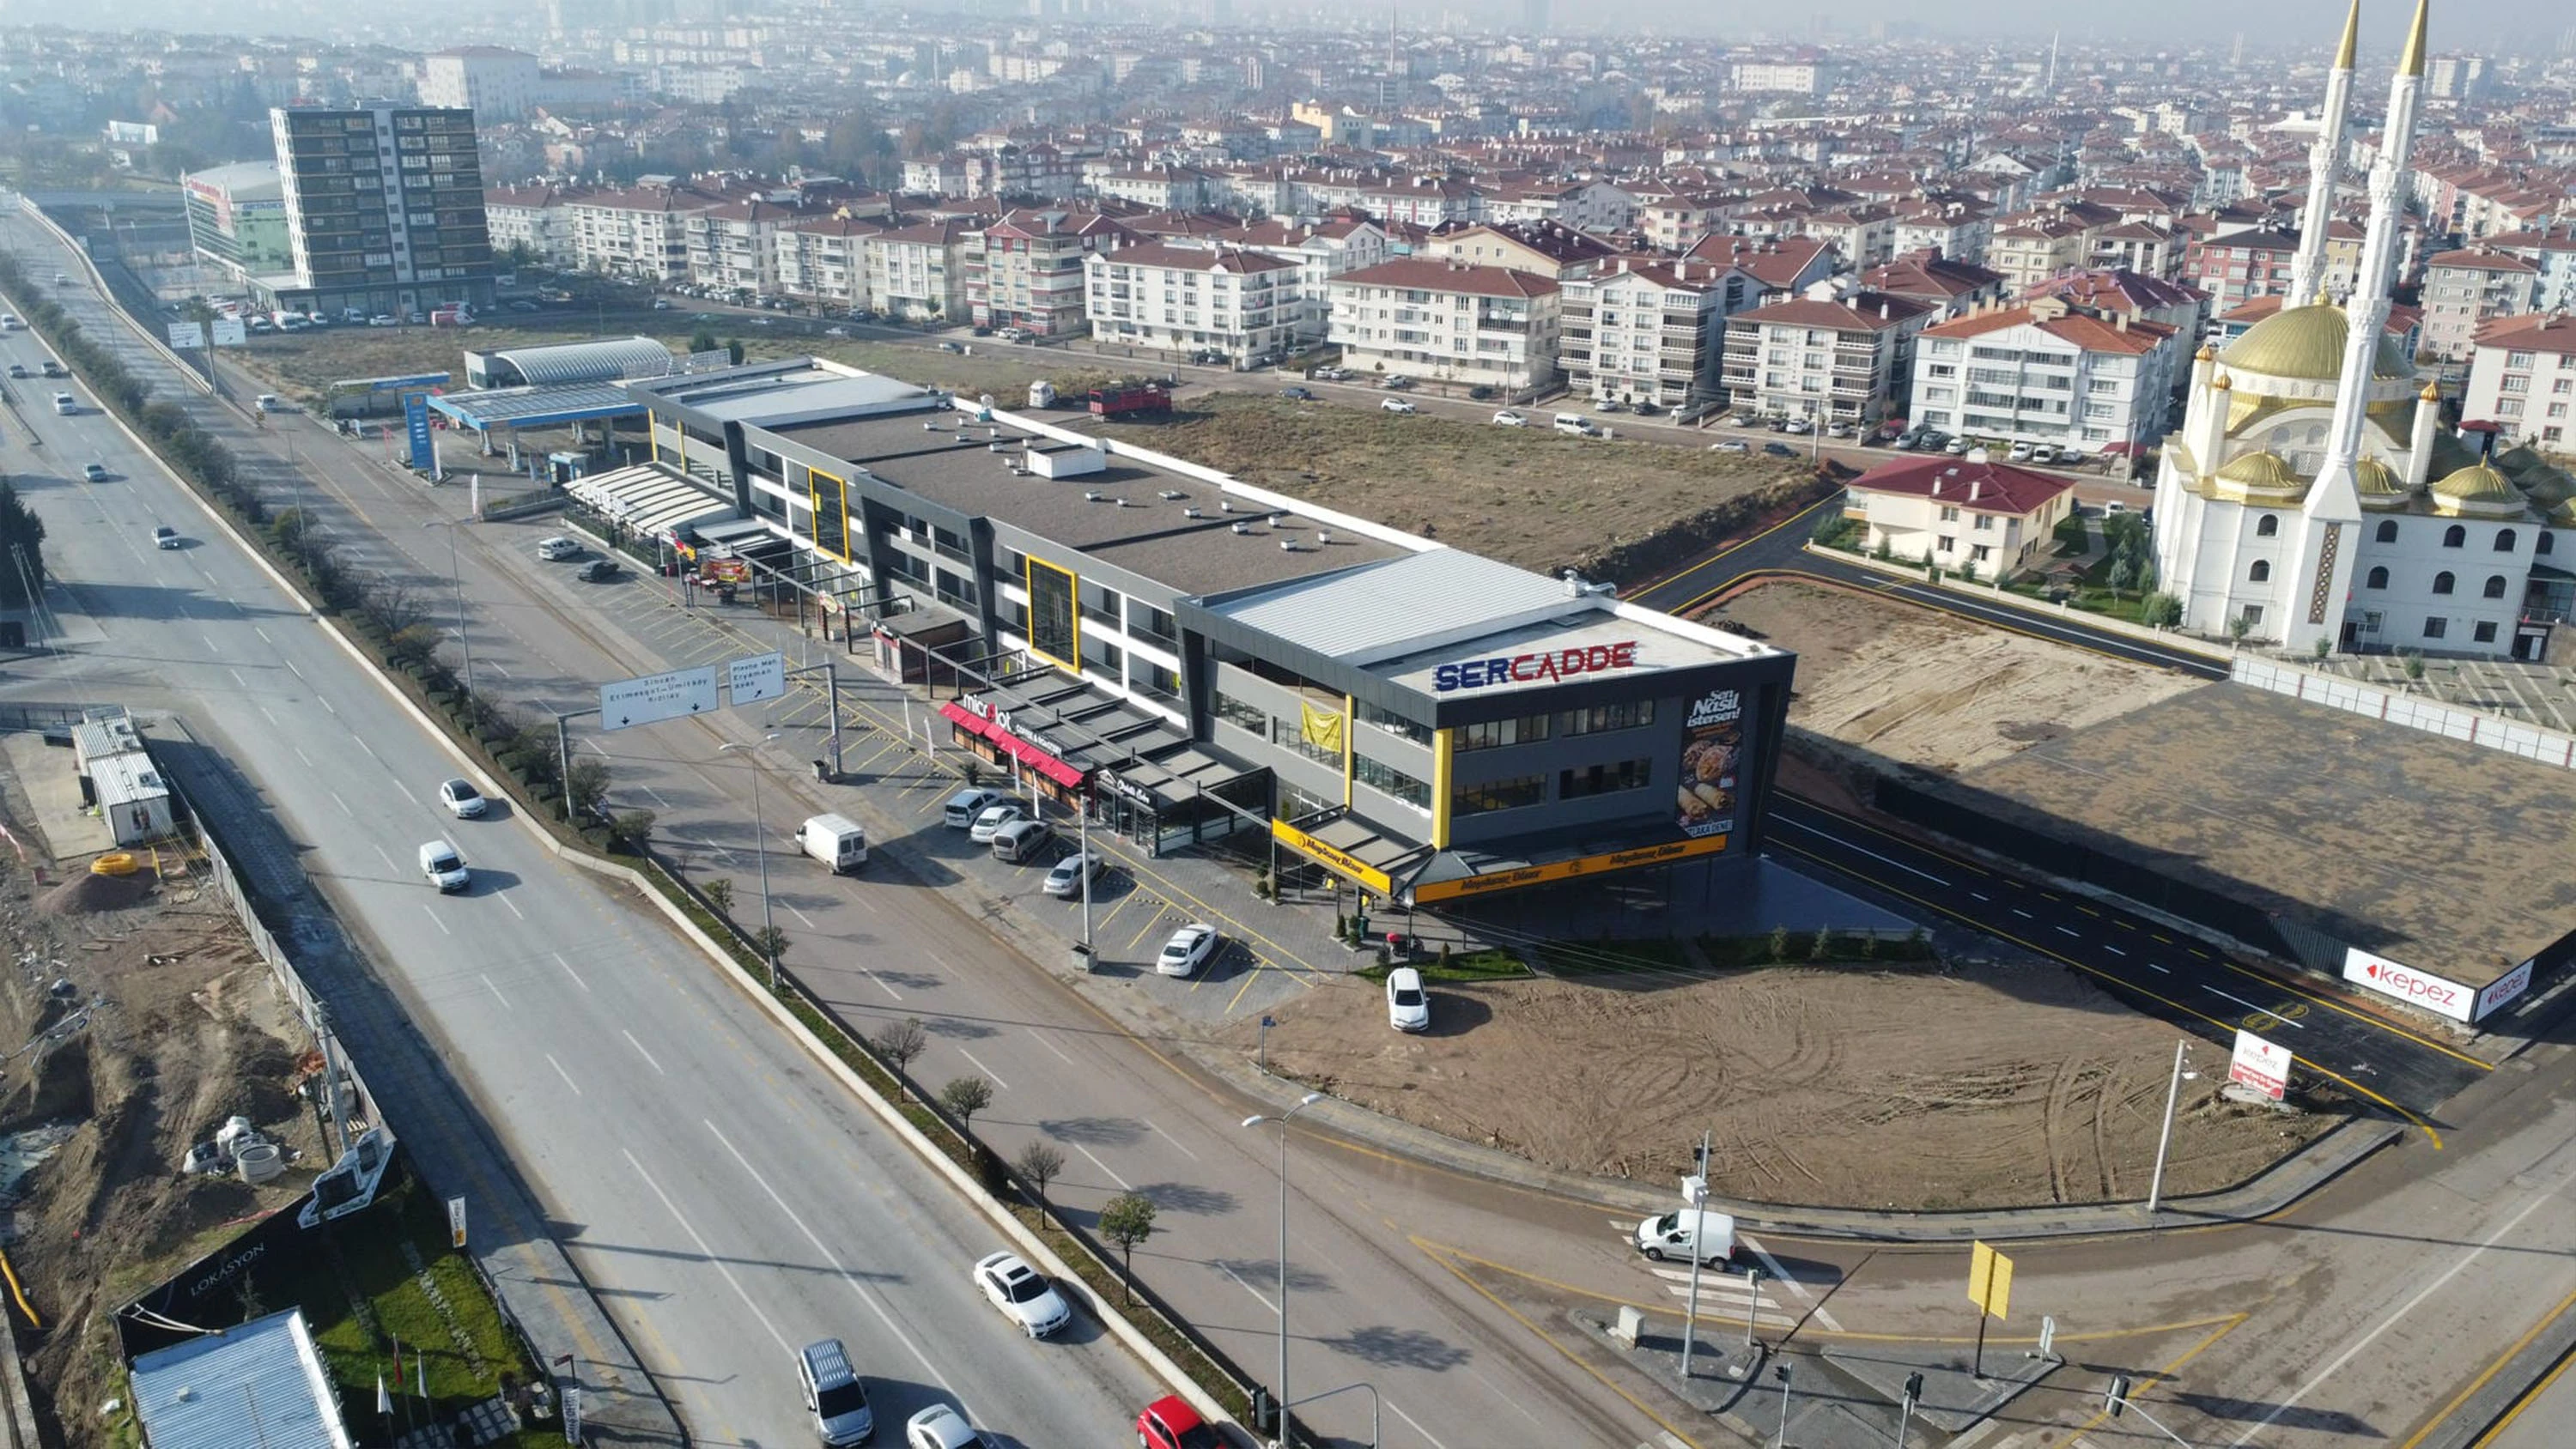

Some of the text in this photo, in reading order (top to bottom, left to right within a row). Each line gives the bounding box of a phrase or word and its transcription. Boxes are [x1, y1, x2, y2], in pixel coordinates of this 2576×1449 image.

[643, 676, 676, 687] Sincan
[1435, 641, 1637, 692] SERCADDE
[1710, 689, 1735, 701] Sen
[2379, 964, 2458, 1007] kepez
[2492, 971, 2526, 1003] kepez
[191, 1242, 264, 1297] LOKASYON
